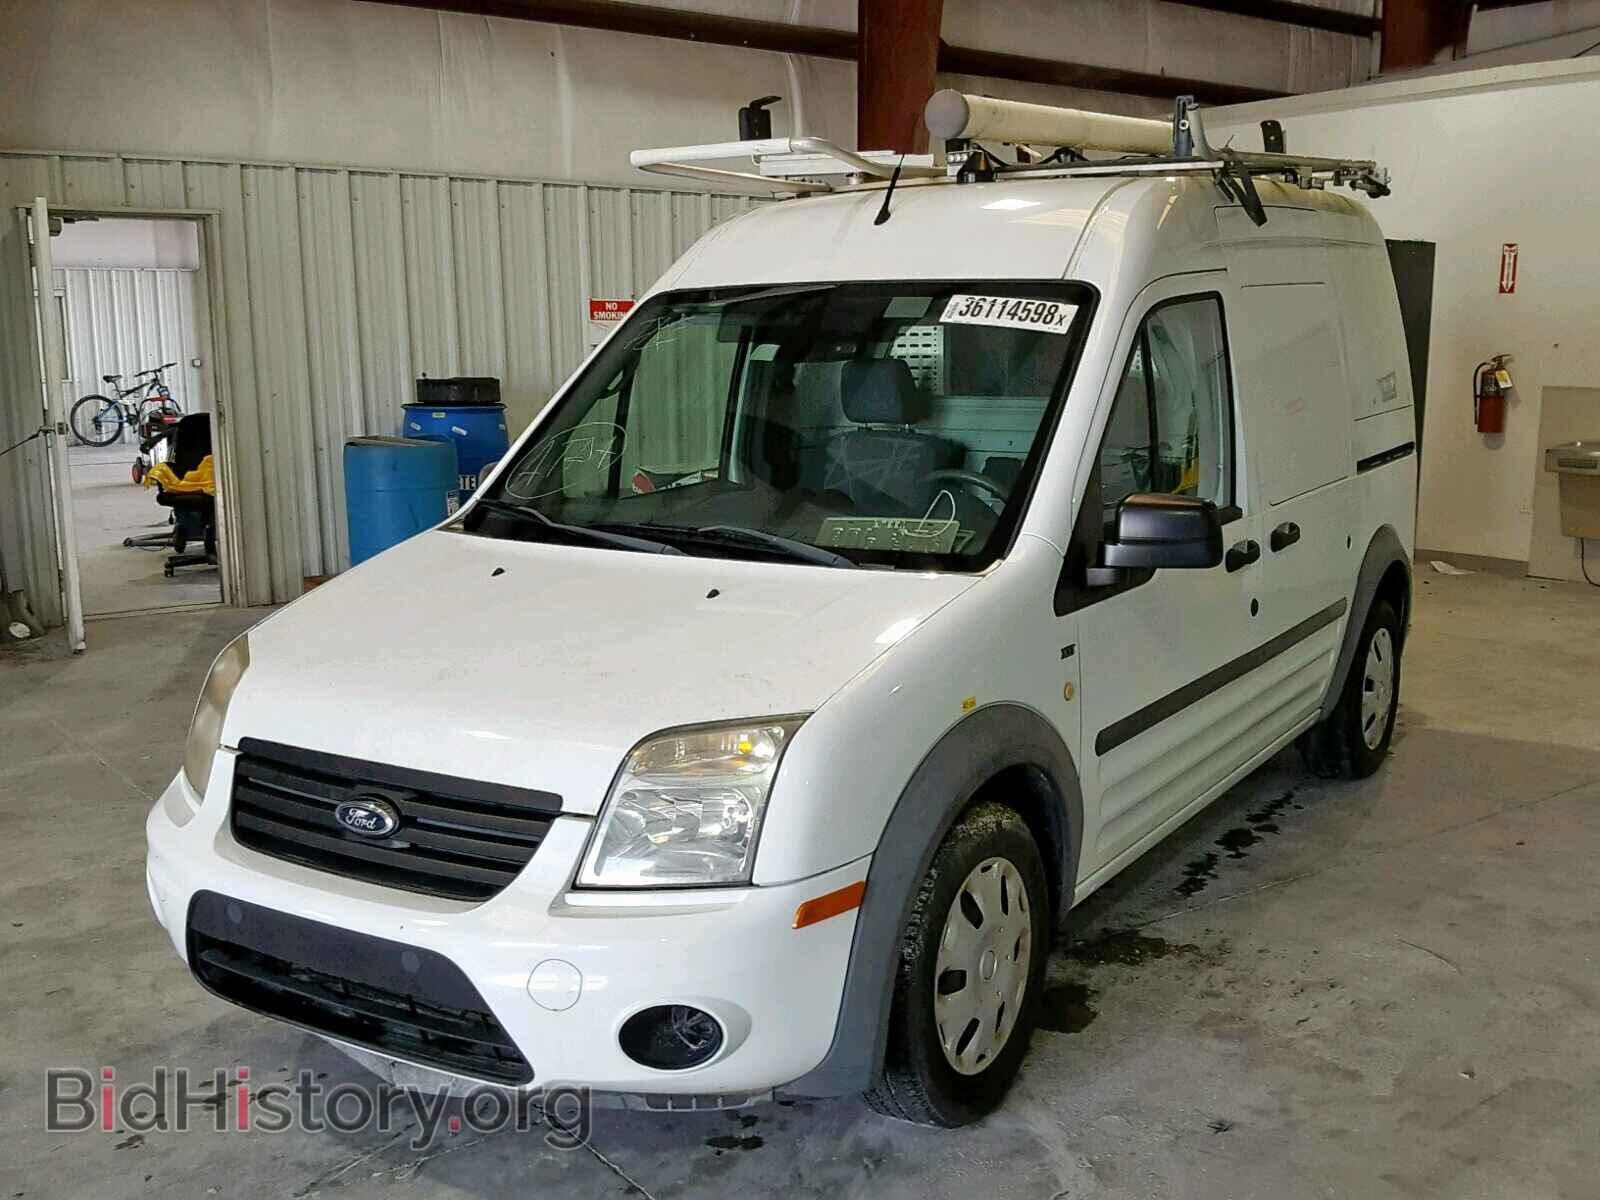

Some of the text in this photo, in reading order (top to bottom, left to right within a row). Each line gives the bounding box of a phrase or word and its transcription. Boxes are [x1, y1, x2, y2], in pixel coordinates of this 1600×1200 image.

[604, 301, 618, 311] NO
[593, 311, 628, 320] SMOKIN
[345, 807, 377, 830] Ford
